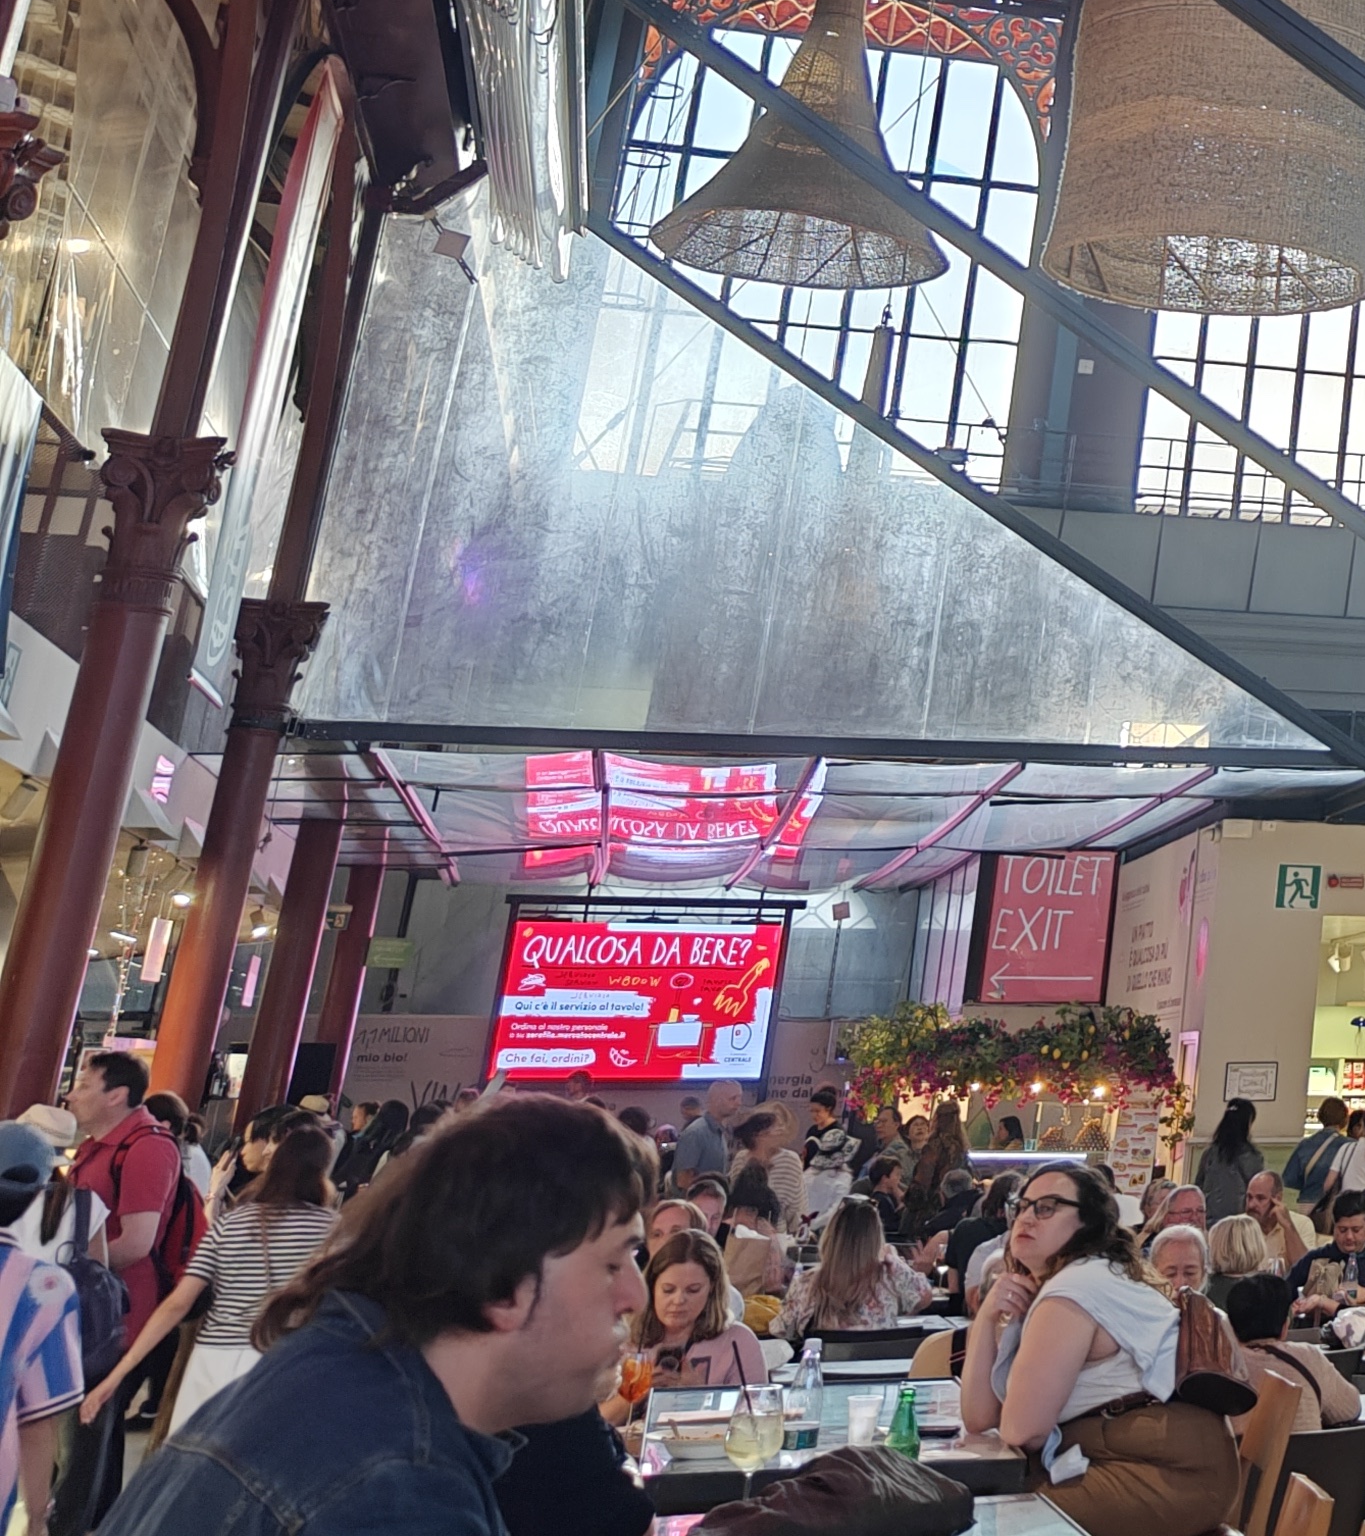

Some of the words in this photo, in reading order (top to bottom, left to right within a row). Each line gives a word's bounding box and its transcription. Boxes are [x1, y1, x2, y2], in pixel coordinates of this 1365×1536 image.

[1003, 855, 1111, 896] TOILET
[991, 906, 1074, 952] EXIT
[523, 935, 642, 969] QUALCOSA
[652, 936, 682, 965] DA
[690, 936, 753, 965] BERE?
[515, 1001, 533, 1011] Qui
[551, 1001, 557, 1011] il
[560, 1001, 597, 1011] servizio
[599, 1001, 609, 1011] al
[611, 1002, 644, 1012] tavolo!
[378, 1026, 430, 1044] MILIONI
[505, 1053, 528, 1063] Che
[530, 1053, 548, 1064] fai,
[551, 1053, 590, 1063] ordini?
